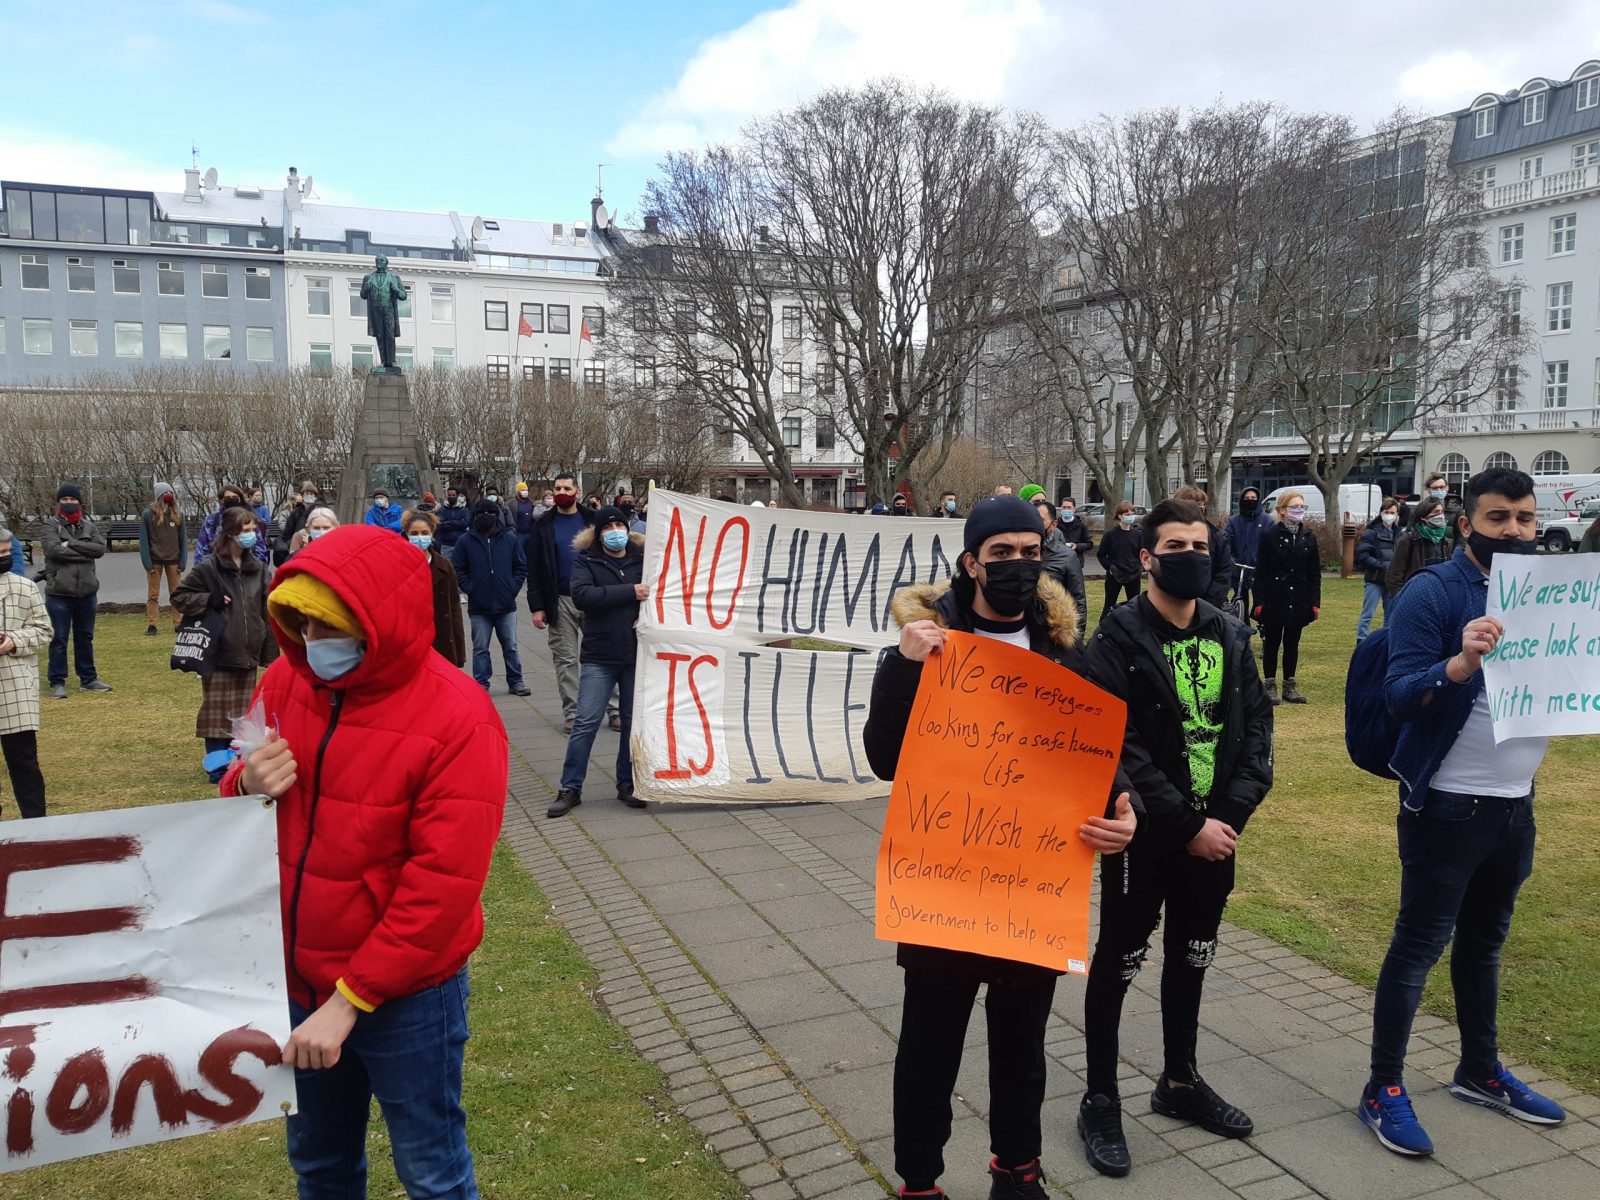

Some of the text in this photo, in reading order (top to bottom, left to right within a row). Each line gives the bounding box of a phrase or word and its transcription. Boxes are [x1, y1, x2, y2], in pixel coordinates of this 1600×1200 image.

[656, 506, 750, 630] NO
[1499, 570, 1533, 612] We
[1535, 580, 1568, 605] are
[1545, 622, 1579, 658] look
[937, 644, 1104, 716] We are refugees
[654, 650, 887, 784] IS ILLE
[986, 720, 1012, 749] for
[1018, 735, 1028, 746] a
[1031, 730, 1065, 752] safe
[1068, 727, 1115, 759] human
[906, 780, 1068, 853] We Wish the
[888, 837, 1071, 900] Icelandic people and
[984, 916, 999, 935] to
[1007, 909, 1037, 947] help
[1045, 933, 1067, 951] us
